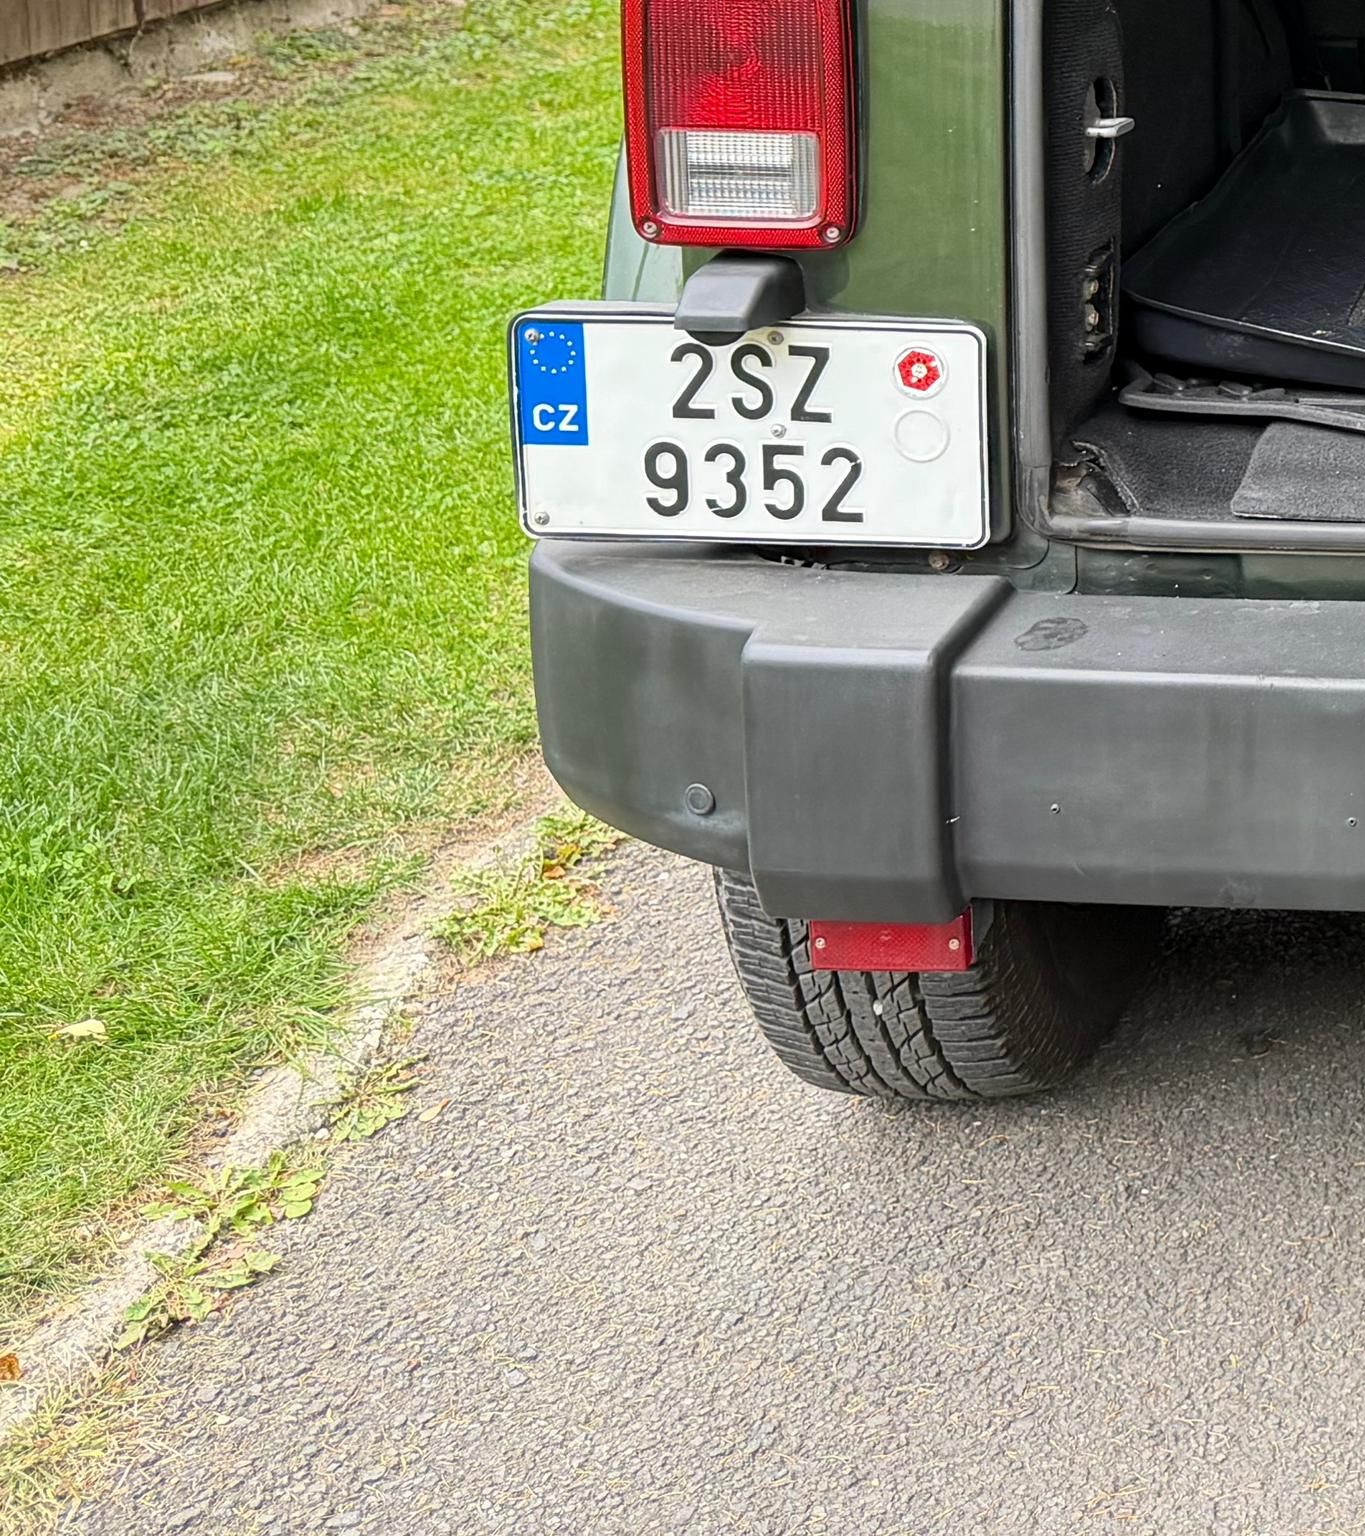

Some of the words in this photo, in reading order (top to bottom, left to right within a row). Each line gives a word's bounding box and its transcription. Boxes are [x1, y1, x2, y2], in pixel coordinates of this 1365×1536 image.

[532, 402, 580, 433] CZ
[670, 342, 833, 424] 2SZ
[644, 441, 864, 523] 9352
